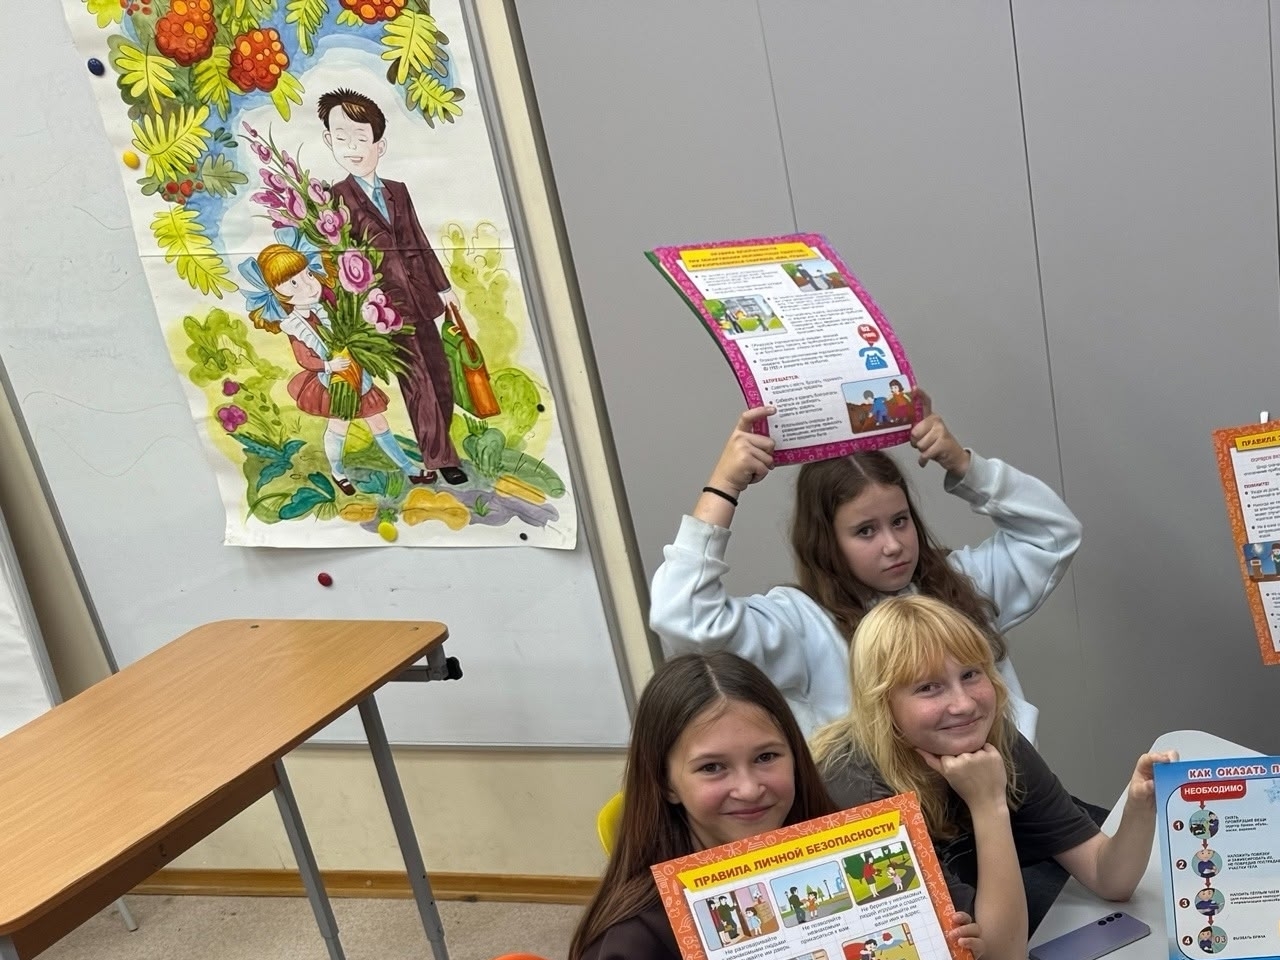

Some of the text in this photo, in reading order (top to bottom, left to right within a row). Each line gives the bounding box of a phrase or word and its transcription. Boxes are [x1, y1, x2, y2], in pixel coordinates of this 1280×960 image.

[1241, 435, 1276, 446] ПРАВИЛА
[1188, 768, 1211, 779] КАК
[1216, 765, 1267, 777] ОКАЗАТЬ
[1184, 784, 1243, 794] НЕОБХОДИМО
[693, 821, 895, 887] ПРАВИЛА ЛИЧНОЙ БЕЗОПАСНОСТИ
